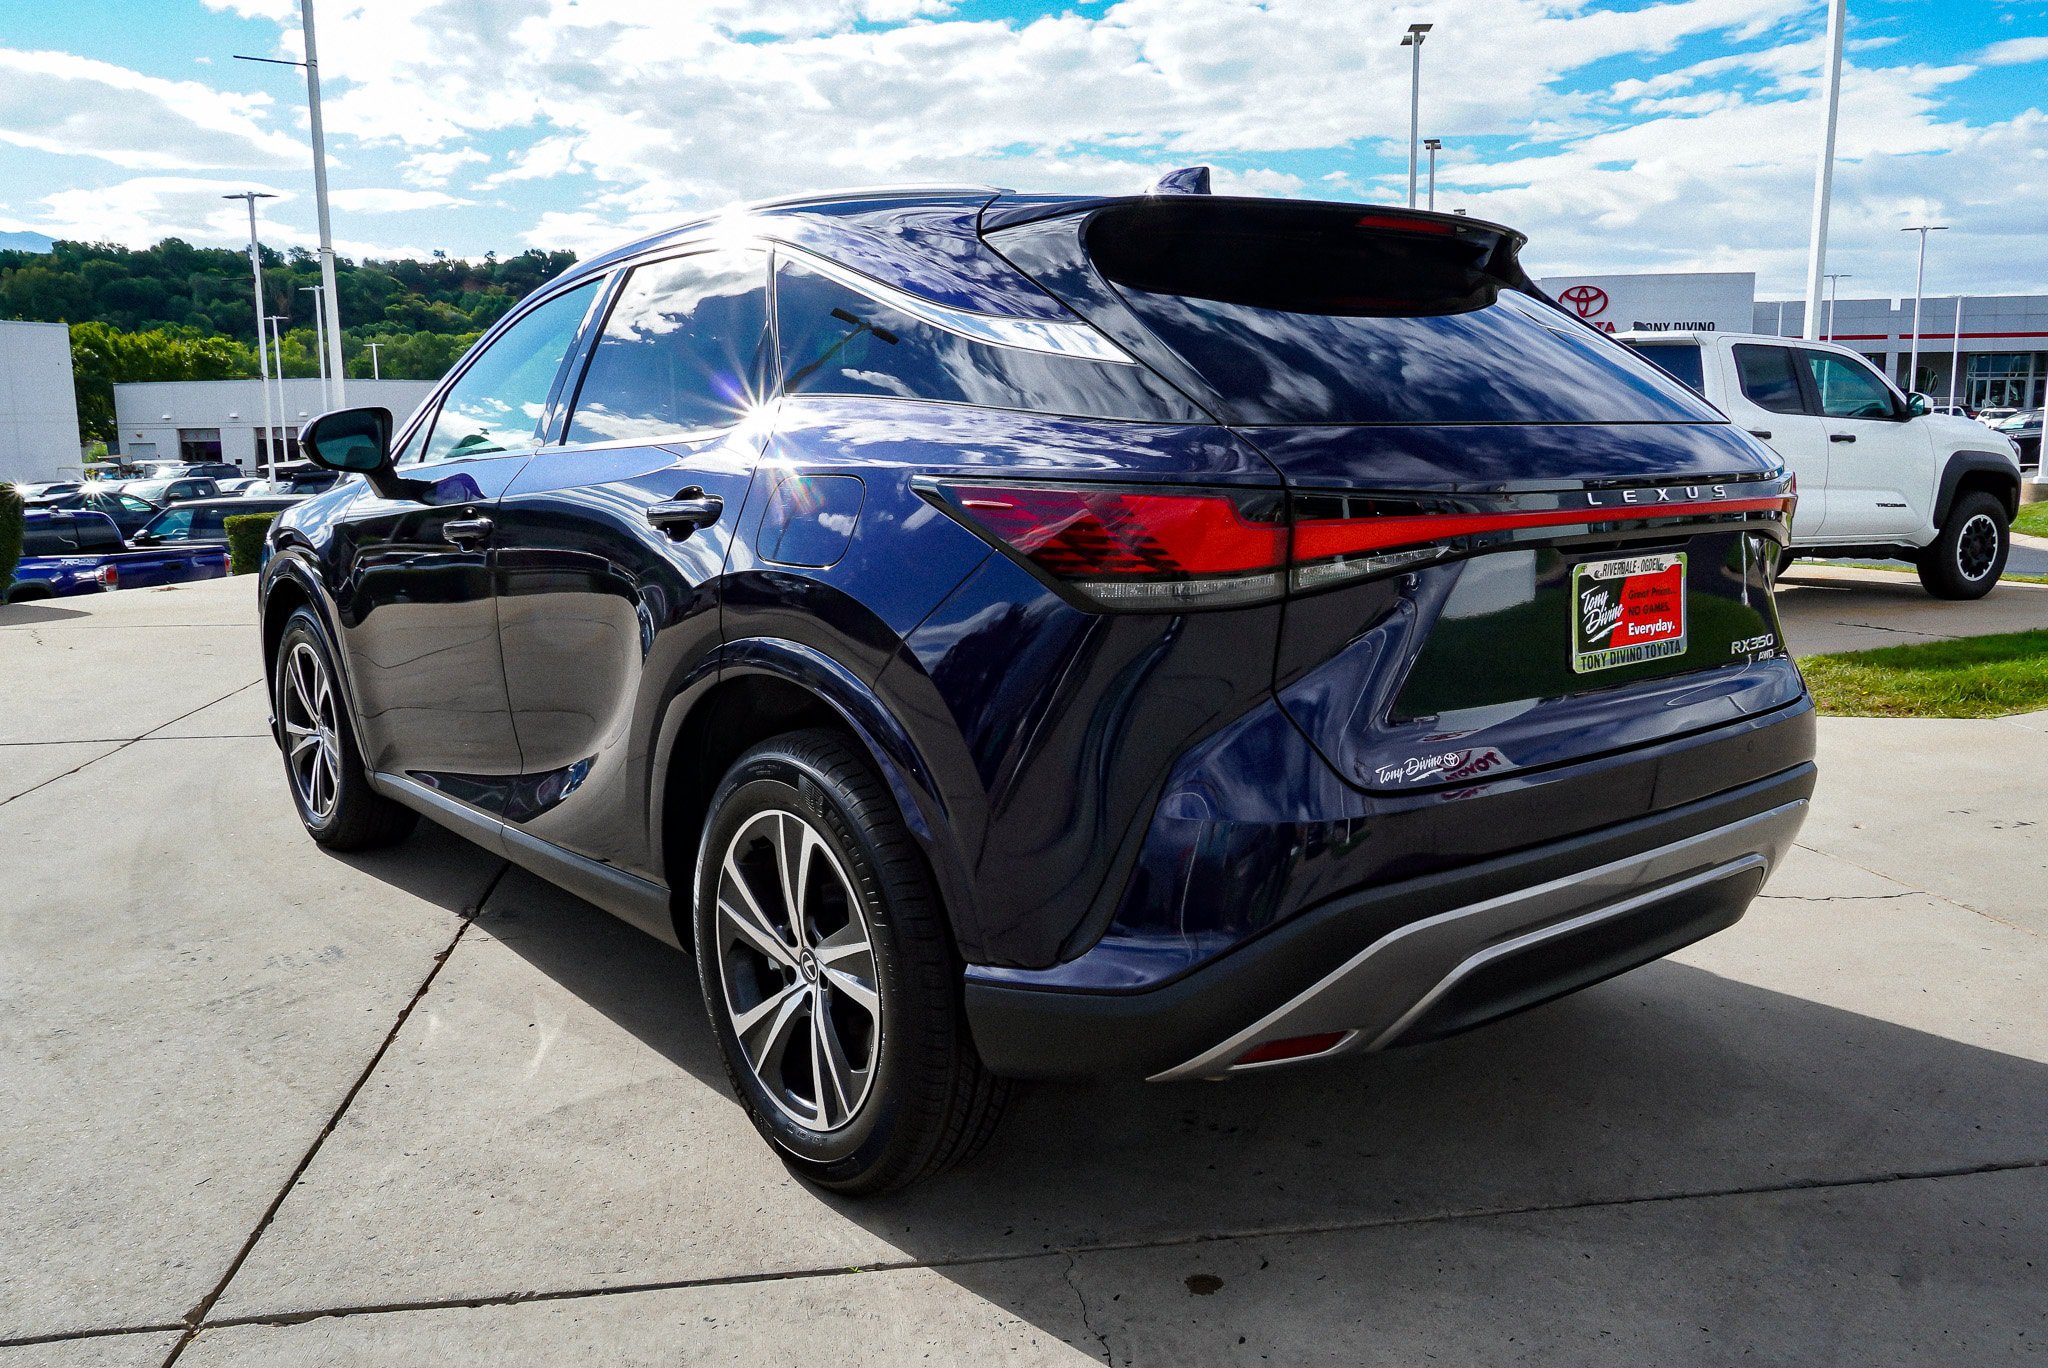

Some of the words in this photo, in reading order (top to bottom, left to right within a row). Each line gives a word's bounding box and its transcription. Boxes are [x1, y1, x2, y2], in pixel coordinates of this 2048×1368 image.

[1587, 485, 1727, 506] LEXUS
[1602, 561, 1637, 577] RIVERDALE
[1580, 584, 1609, 614] Tony
[1581, 602, 1624, 634] Divino
[1628, 605, 1640, 617] NO
[1628, 618, 1676, 636] Everyday.
[1731, 633, 1774, 654] RX350
[1581, 652, 1607, 671] TONY
[1610, 646, 1642, 666] DIVINO
[1644, 640, 1681, 661] TOYOTA
[1758, 649, 1774, 661] AWD
[1375, 763, 1405, 784] Tony
[1403, 754, 1442, 776] Divino
